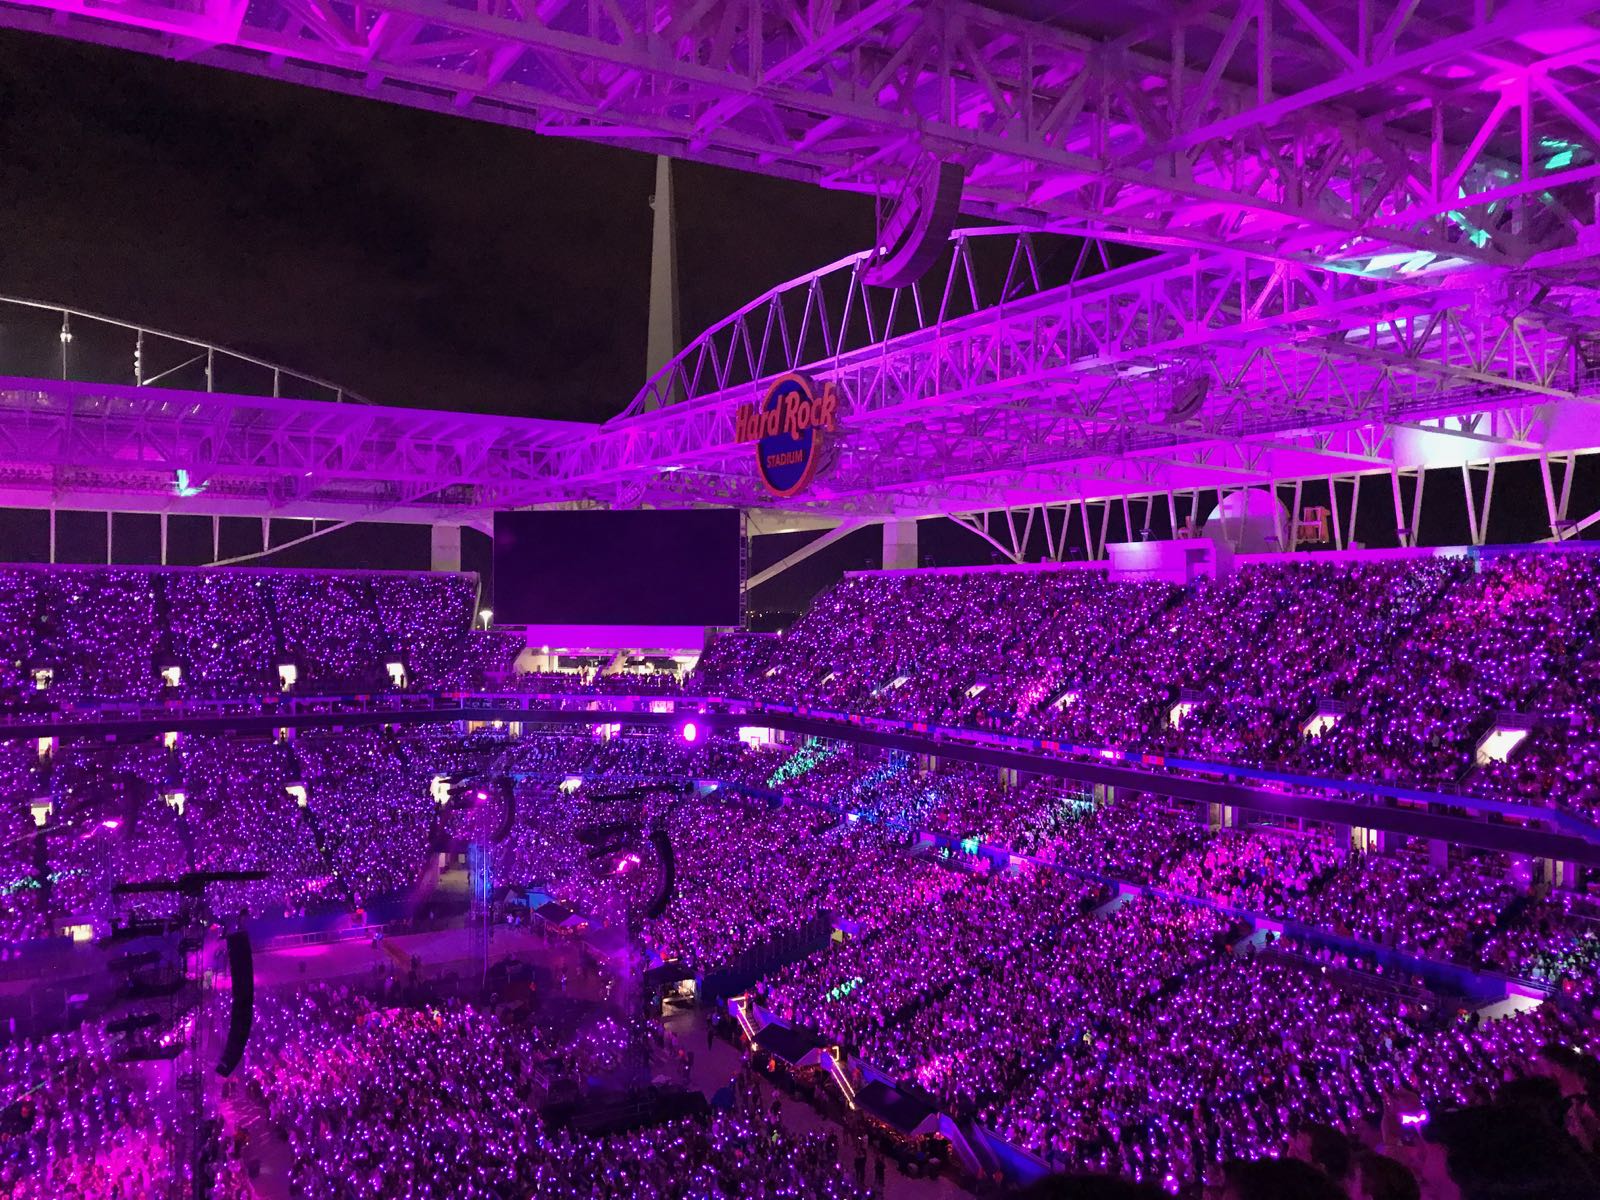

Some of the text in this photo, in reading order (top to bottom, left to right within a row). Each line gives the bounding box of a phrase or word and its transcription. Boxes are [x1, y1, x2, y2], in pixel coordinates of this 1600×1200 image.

[736, 382, 836, 443] Hard Rock
[767, 449, 803, 468] STADIUM
